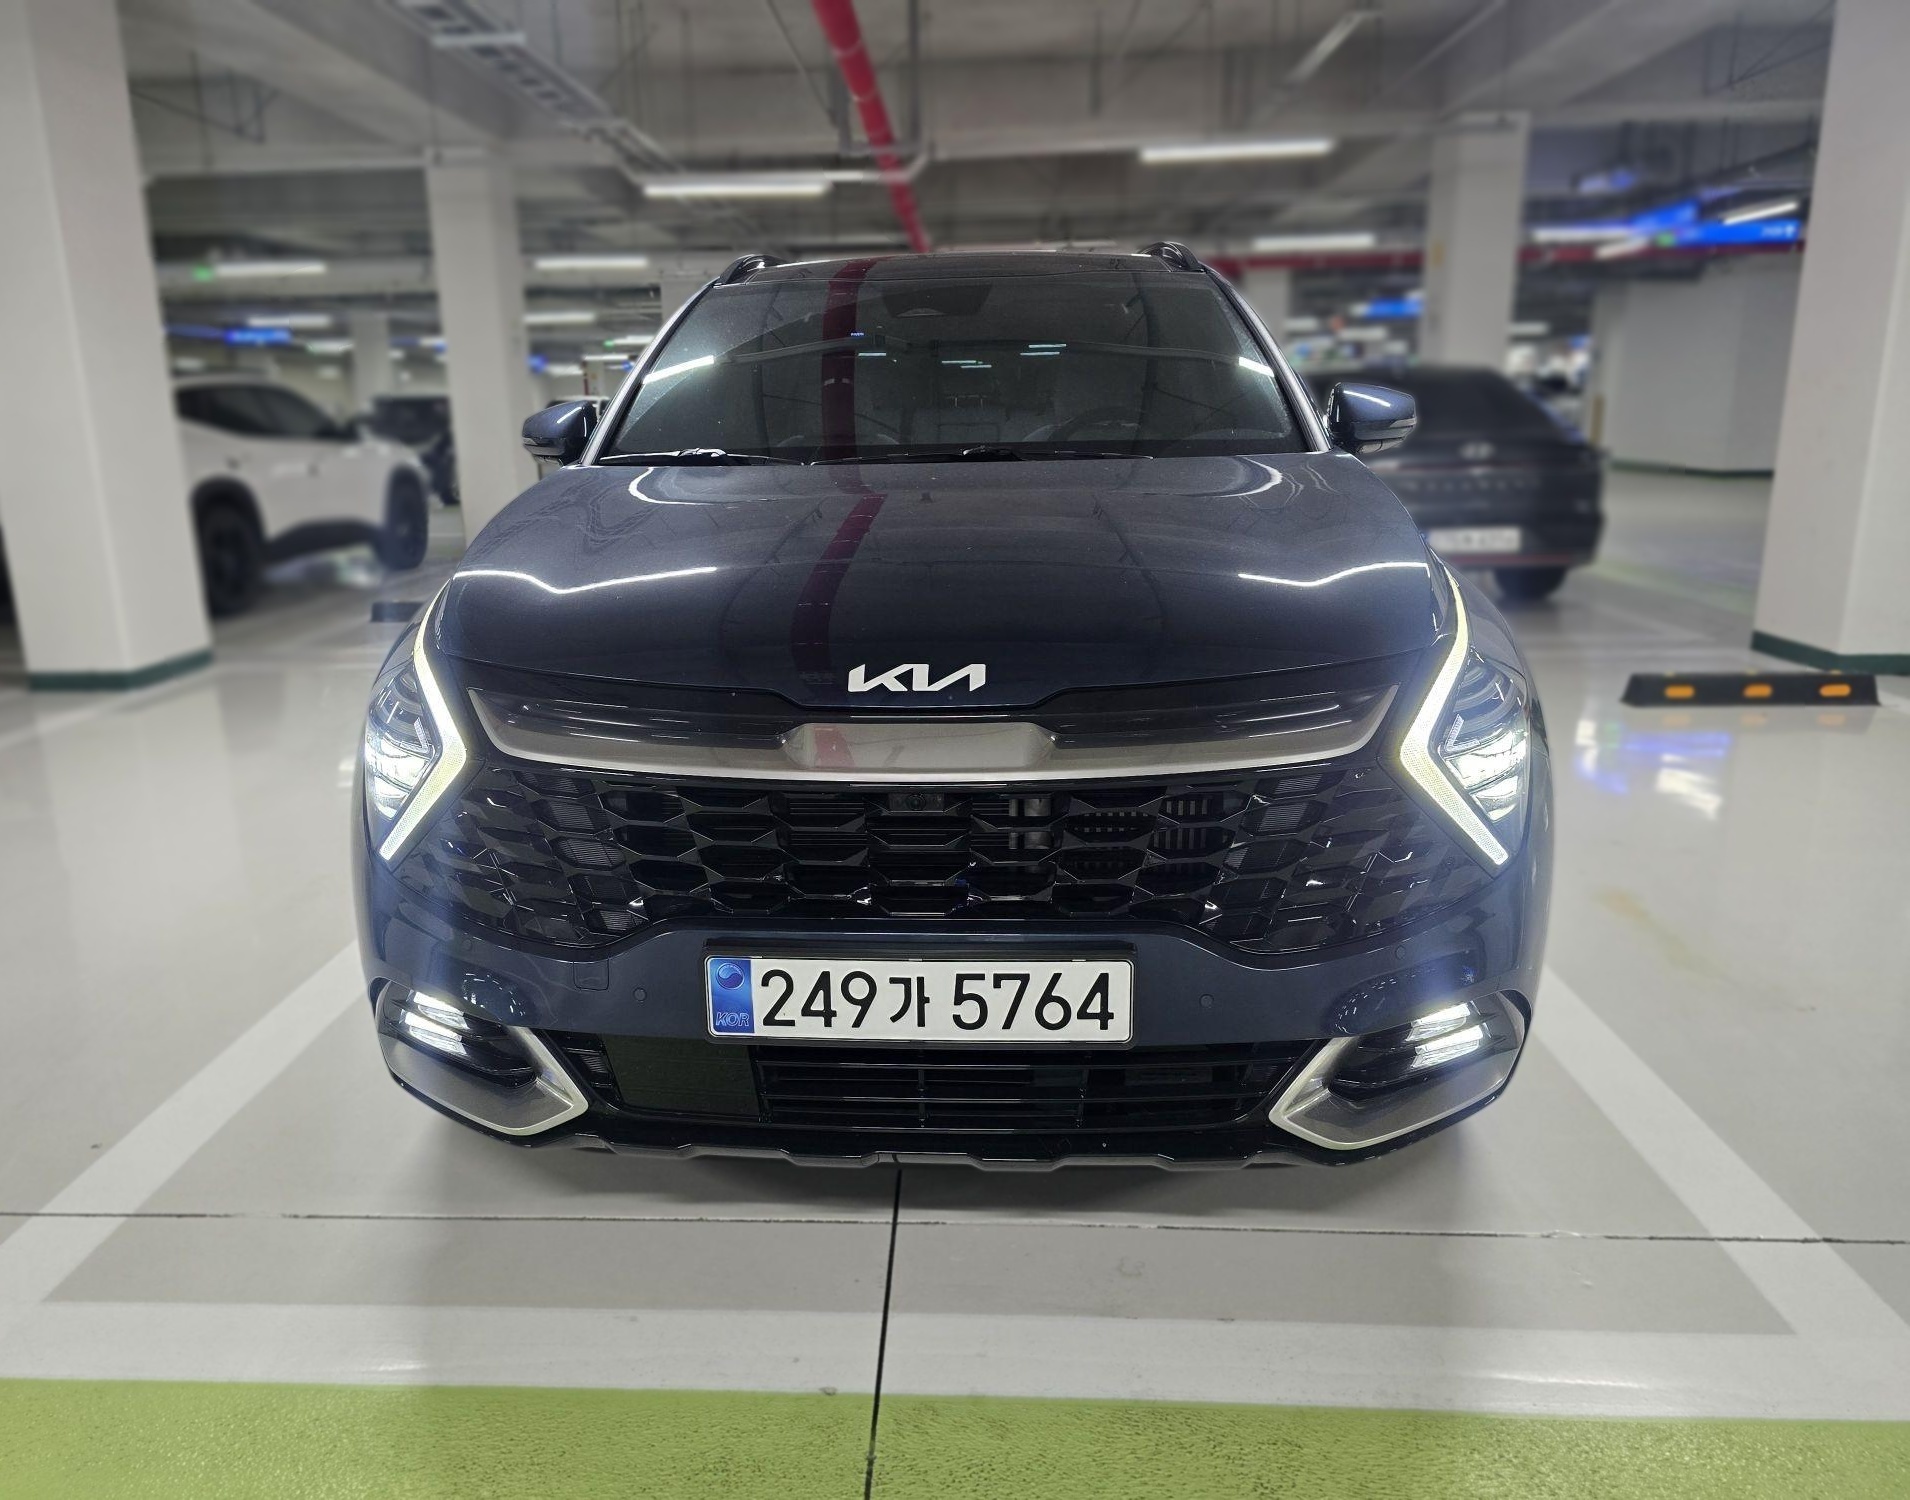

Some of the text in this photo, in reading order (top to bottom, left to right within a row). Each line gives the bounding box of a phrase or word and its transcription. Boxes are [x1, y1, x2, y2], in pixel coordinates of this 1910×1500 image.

[848, 664, 986, 692] KIA
[761, 969, 1115, 1031] 249가 5764
[715, 1011, 750, 1027] KOR
